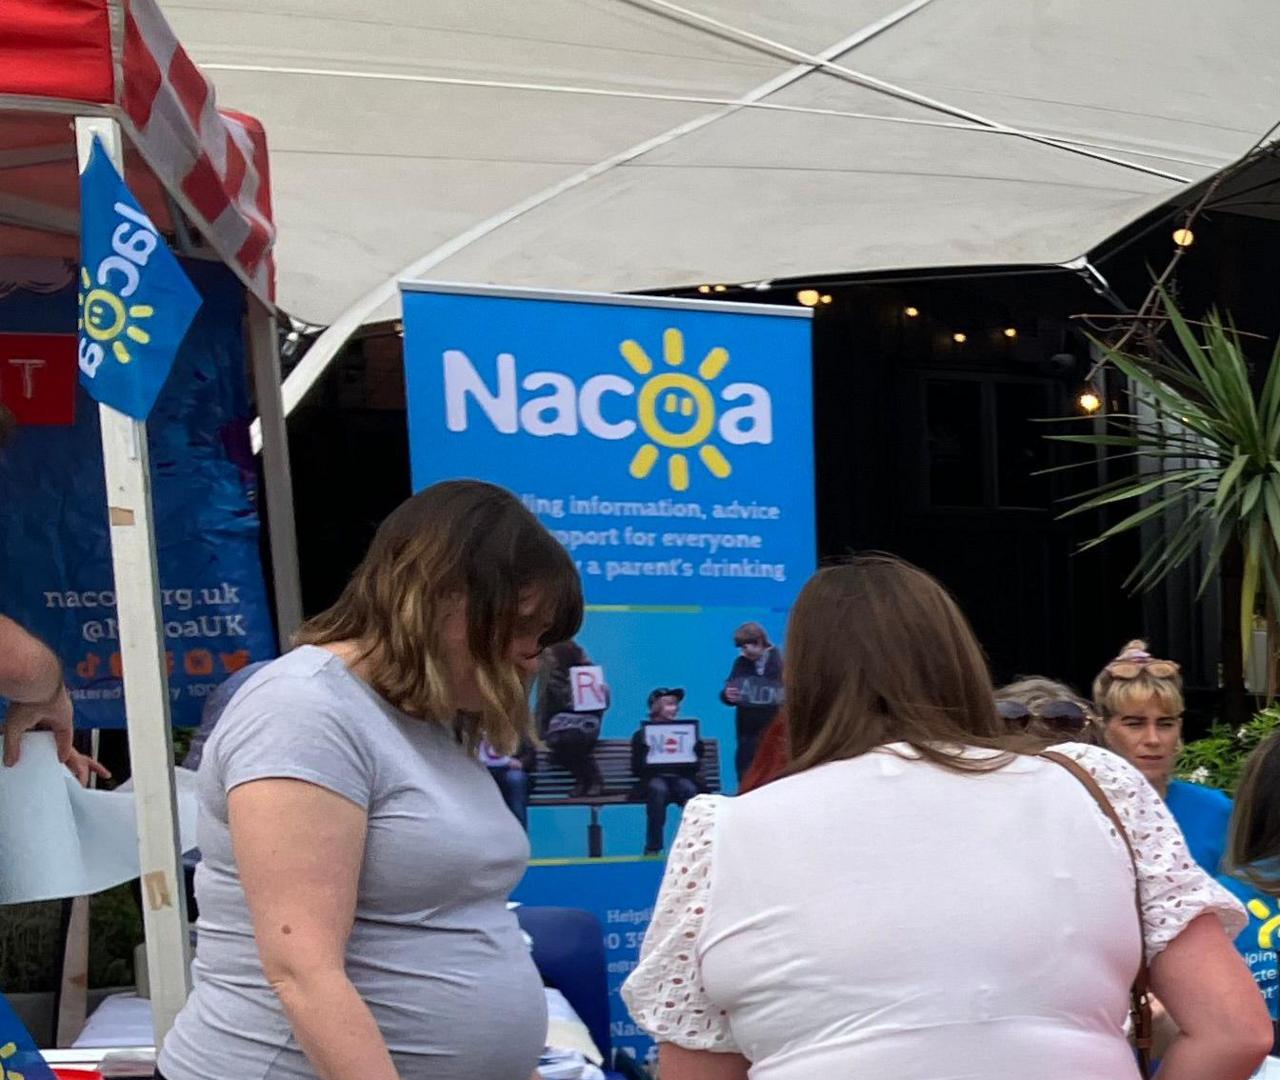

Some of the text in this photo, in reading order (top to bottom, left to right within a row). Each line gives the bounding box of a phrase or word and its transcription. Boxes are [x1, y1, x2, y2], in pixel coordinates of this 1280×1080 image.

[443, 350, 773, 447] Nacoa
[569, 496, 707, 520] information,
[712, 500, 781, 520] advice
[624, 526, 655, 546] for
[662, 532, 762, 554] everyone
[586, 560, 601, 575] a
[605, 557, 694, 581] parent's
[699, 557, 787, 582] drinking
